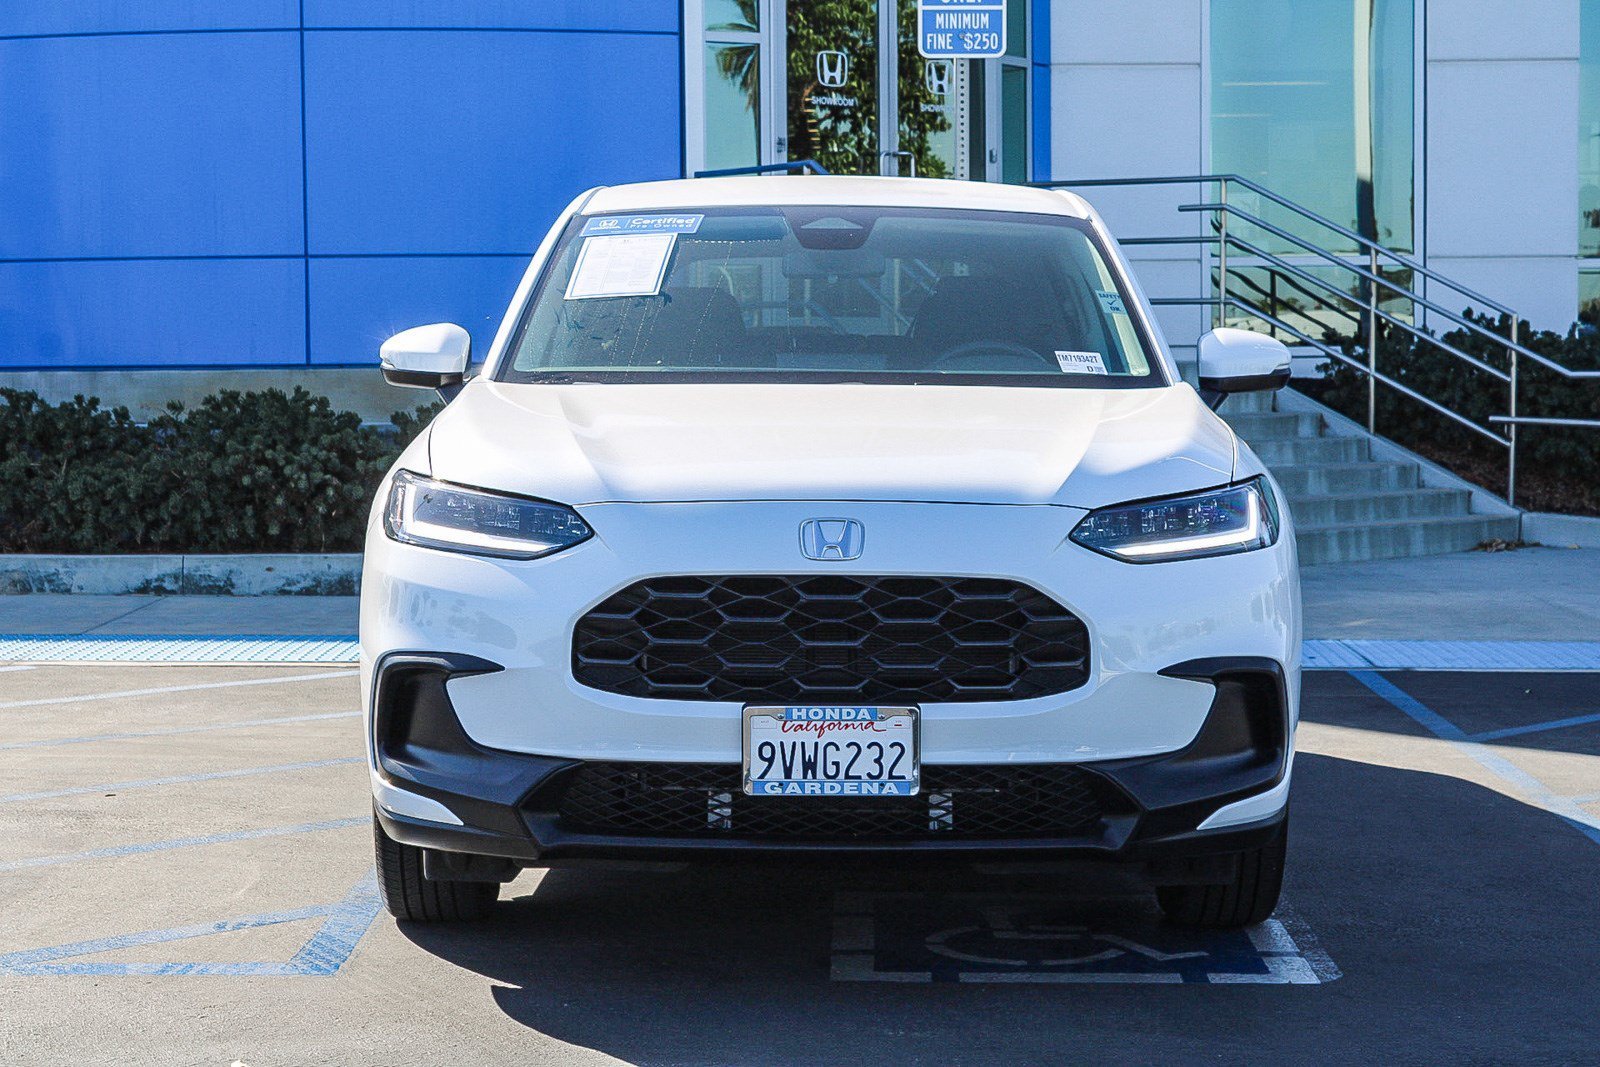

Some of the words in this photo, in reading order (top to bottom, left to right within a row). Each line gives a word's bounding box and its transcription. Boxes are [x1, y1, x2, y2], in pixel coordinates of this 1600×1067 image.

[935, 13, 989, 29] MINIMUM
[926, 33, 953, 50] FINE
[963, 32, 998, 51] $250
[811, 95, 855, 107] SHOWROOM
[632, 217, 696, 225] Certified
[792, 708, 871, 720] HONDA
[781, 720, 887, 739] California
[757, 741, 907, 780] 9VWG232
[764, 782, 900, 795] GARDENA
